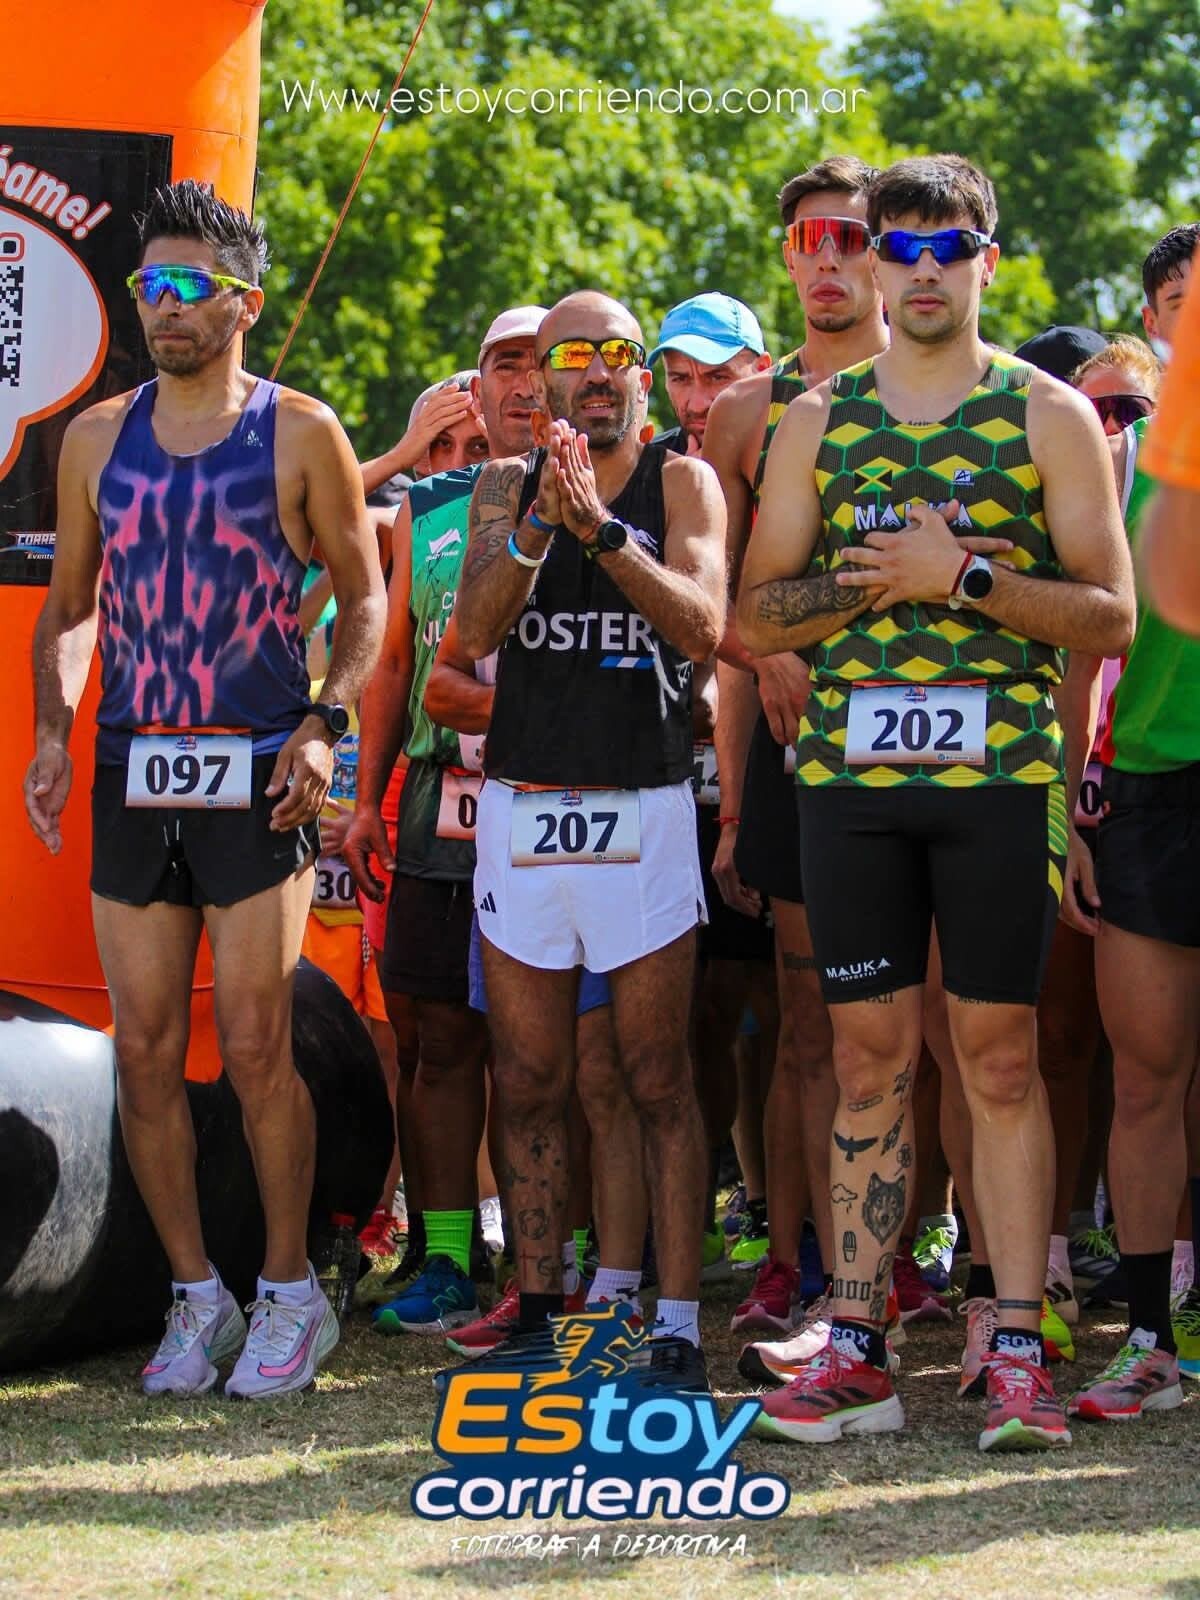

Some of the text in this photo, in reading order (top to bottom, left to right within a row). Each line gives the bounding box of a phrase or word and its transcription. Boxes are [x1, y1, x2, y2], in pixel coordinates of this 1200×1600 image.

[504, 610, 656, 652] OSTER
[871, 708, 964, 751] 202
[145, 754, 231, 796] 097
[533, 811, 619, 855] 207
[825, 957, 890, 979] MAUKA
